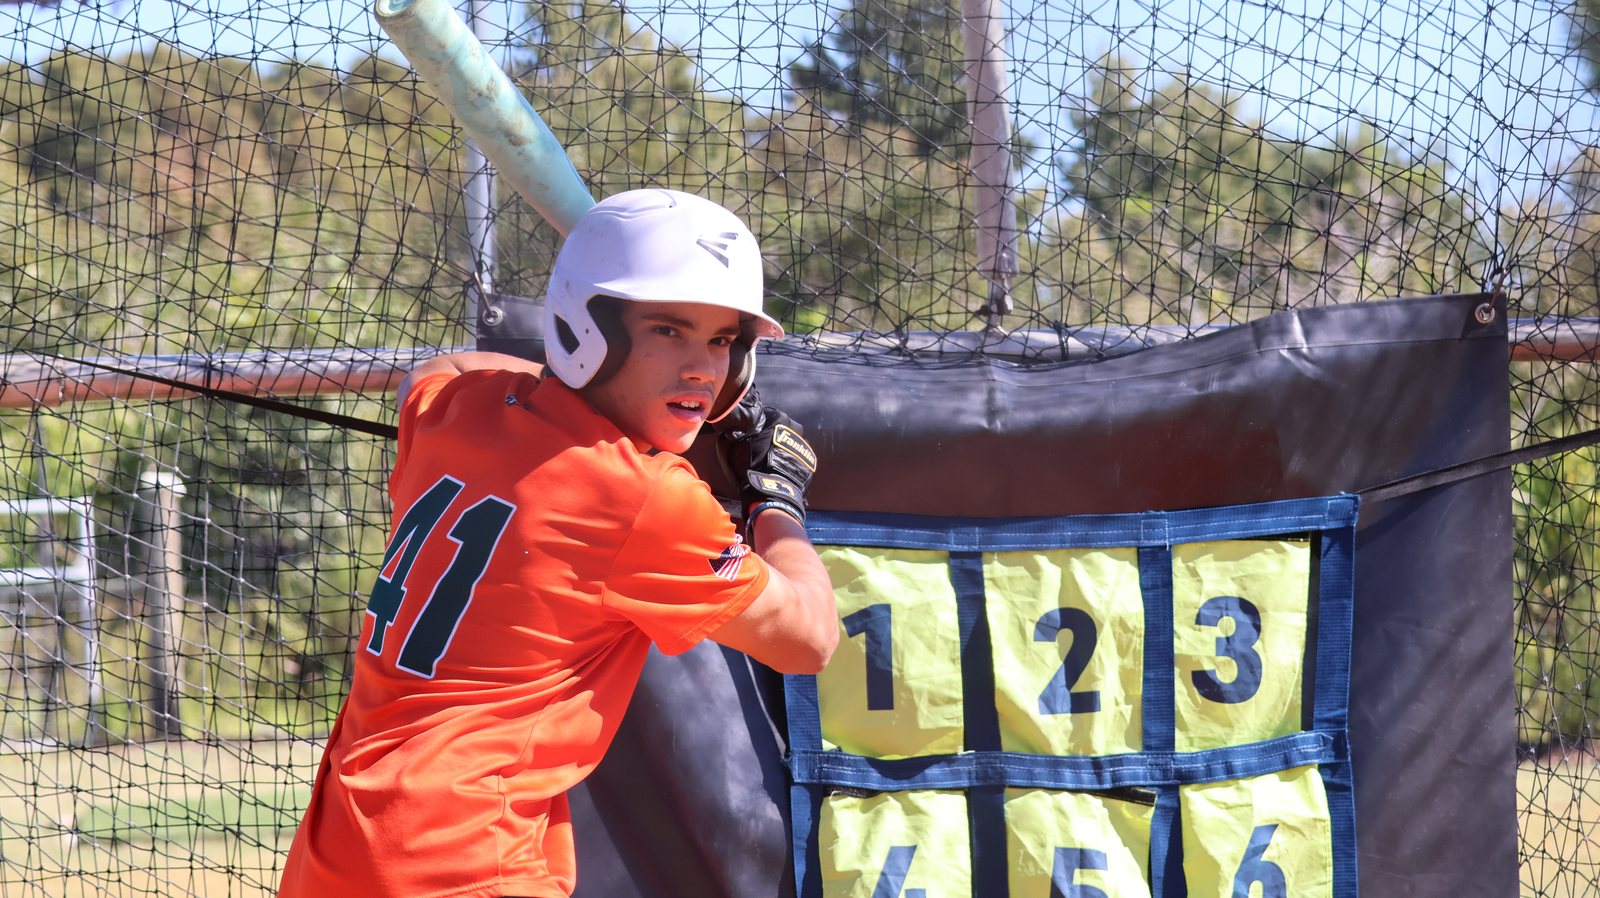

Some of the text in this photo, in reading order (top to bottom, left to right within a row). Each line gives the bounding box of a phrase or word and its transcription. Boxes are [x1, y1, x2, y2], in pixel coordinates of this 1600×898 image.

[776, 430, 815, 465] Franklin
[366, 474, 517, 679] 41
[841, 603, 894, 711] 1
[1033, 607, 1101, 714] 2
[1191, 596, 1262, 704] 3
[1231, 824, 1289, 898] 6
